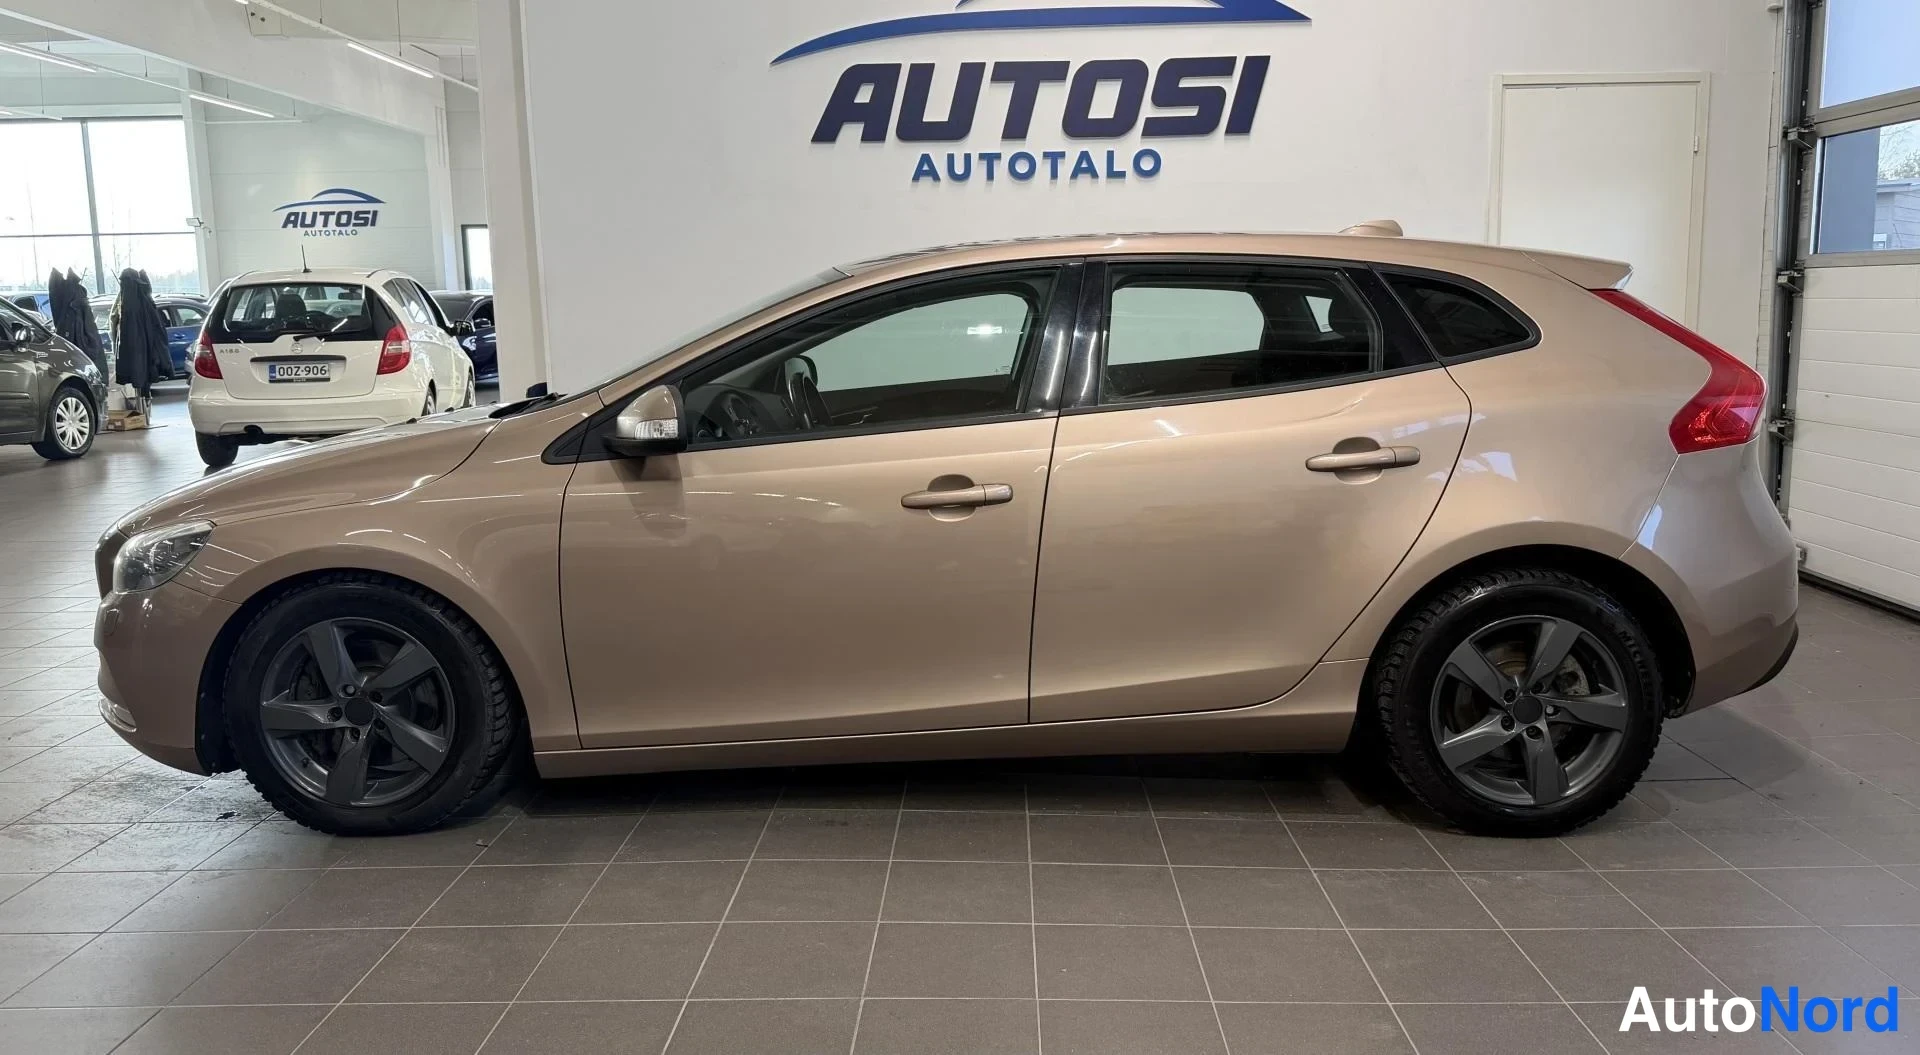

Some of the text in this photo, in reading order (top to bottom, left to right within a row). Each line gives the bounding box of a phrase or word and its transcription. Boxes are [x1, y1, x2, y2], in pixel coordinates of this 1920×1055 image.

[811, 55, 1271, 142] AUTOSI
[911, 148, 1163, 184] AUTOTALO
[281, 210, 378, 228] AUTOSI
[303, 229, 358, 237] AUTOTALO
